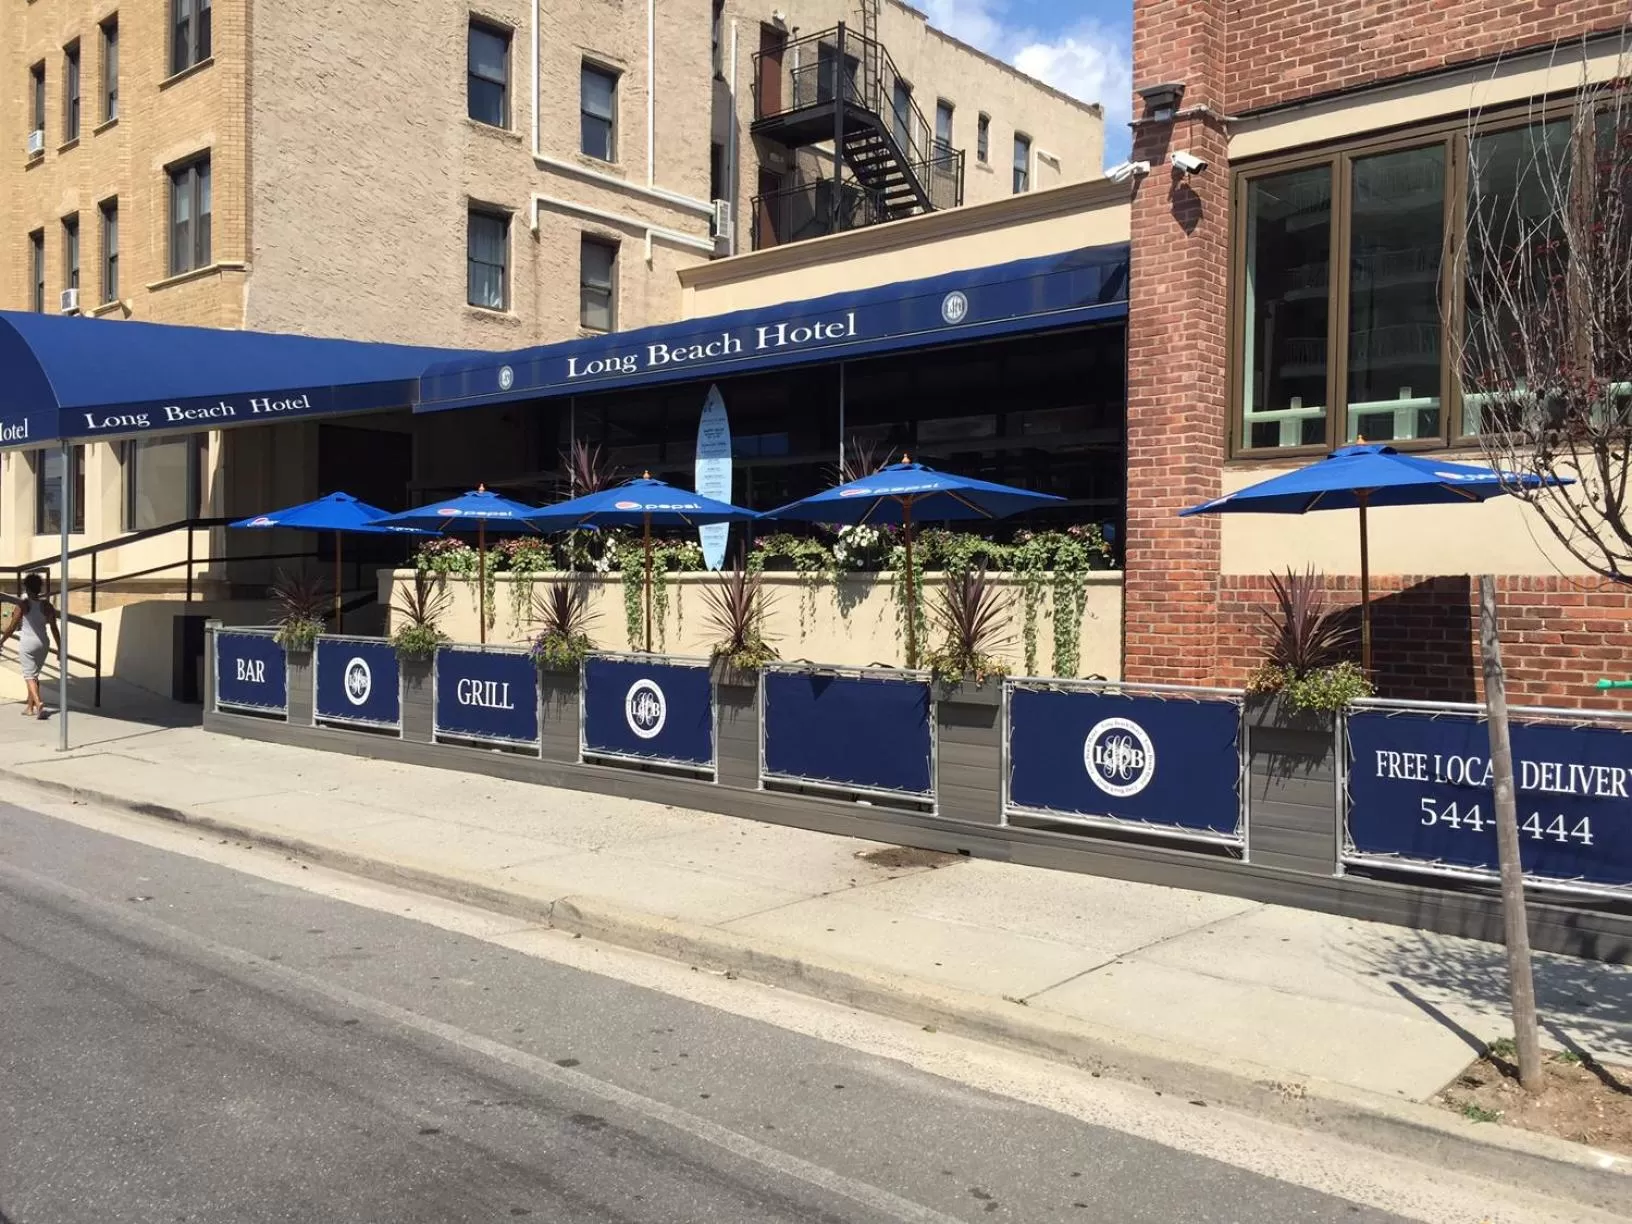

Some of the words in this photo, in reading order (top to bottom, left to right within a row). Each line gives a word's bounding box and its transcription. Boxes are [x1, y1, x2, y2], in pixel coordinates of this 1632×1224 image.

[567, 352, 638, 379] Long
[647, 331, 744, 367] Beach
[756, 312, 858, 349] Hotel
[85, 412, 151, 430] Long
[164, 401, 236, 423] Beach
[250, 394, 312, 414] Hotel
[462, 510, 513, 518] pepsi
[644, 503, 702, 511] pepsi
[236, 658, 265, 683] BAR
[457, 678, 515, 710] GRILL
[1375, 750, 1429, 781] FREE
[1434, 754, 1494, 787] LOCA
[1520, 760, 1632, 799] DELIVER
[1420, 797, 1594, 846] 544-444
